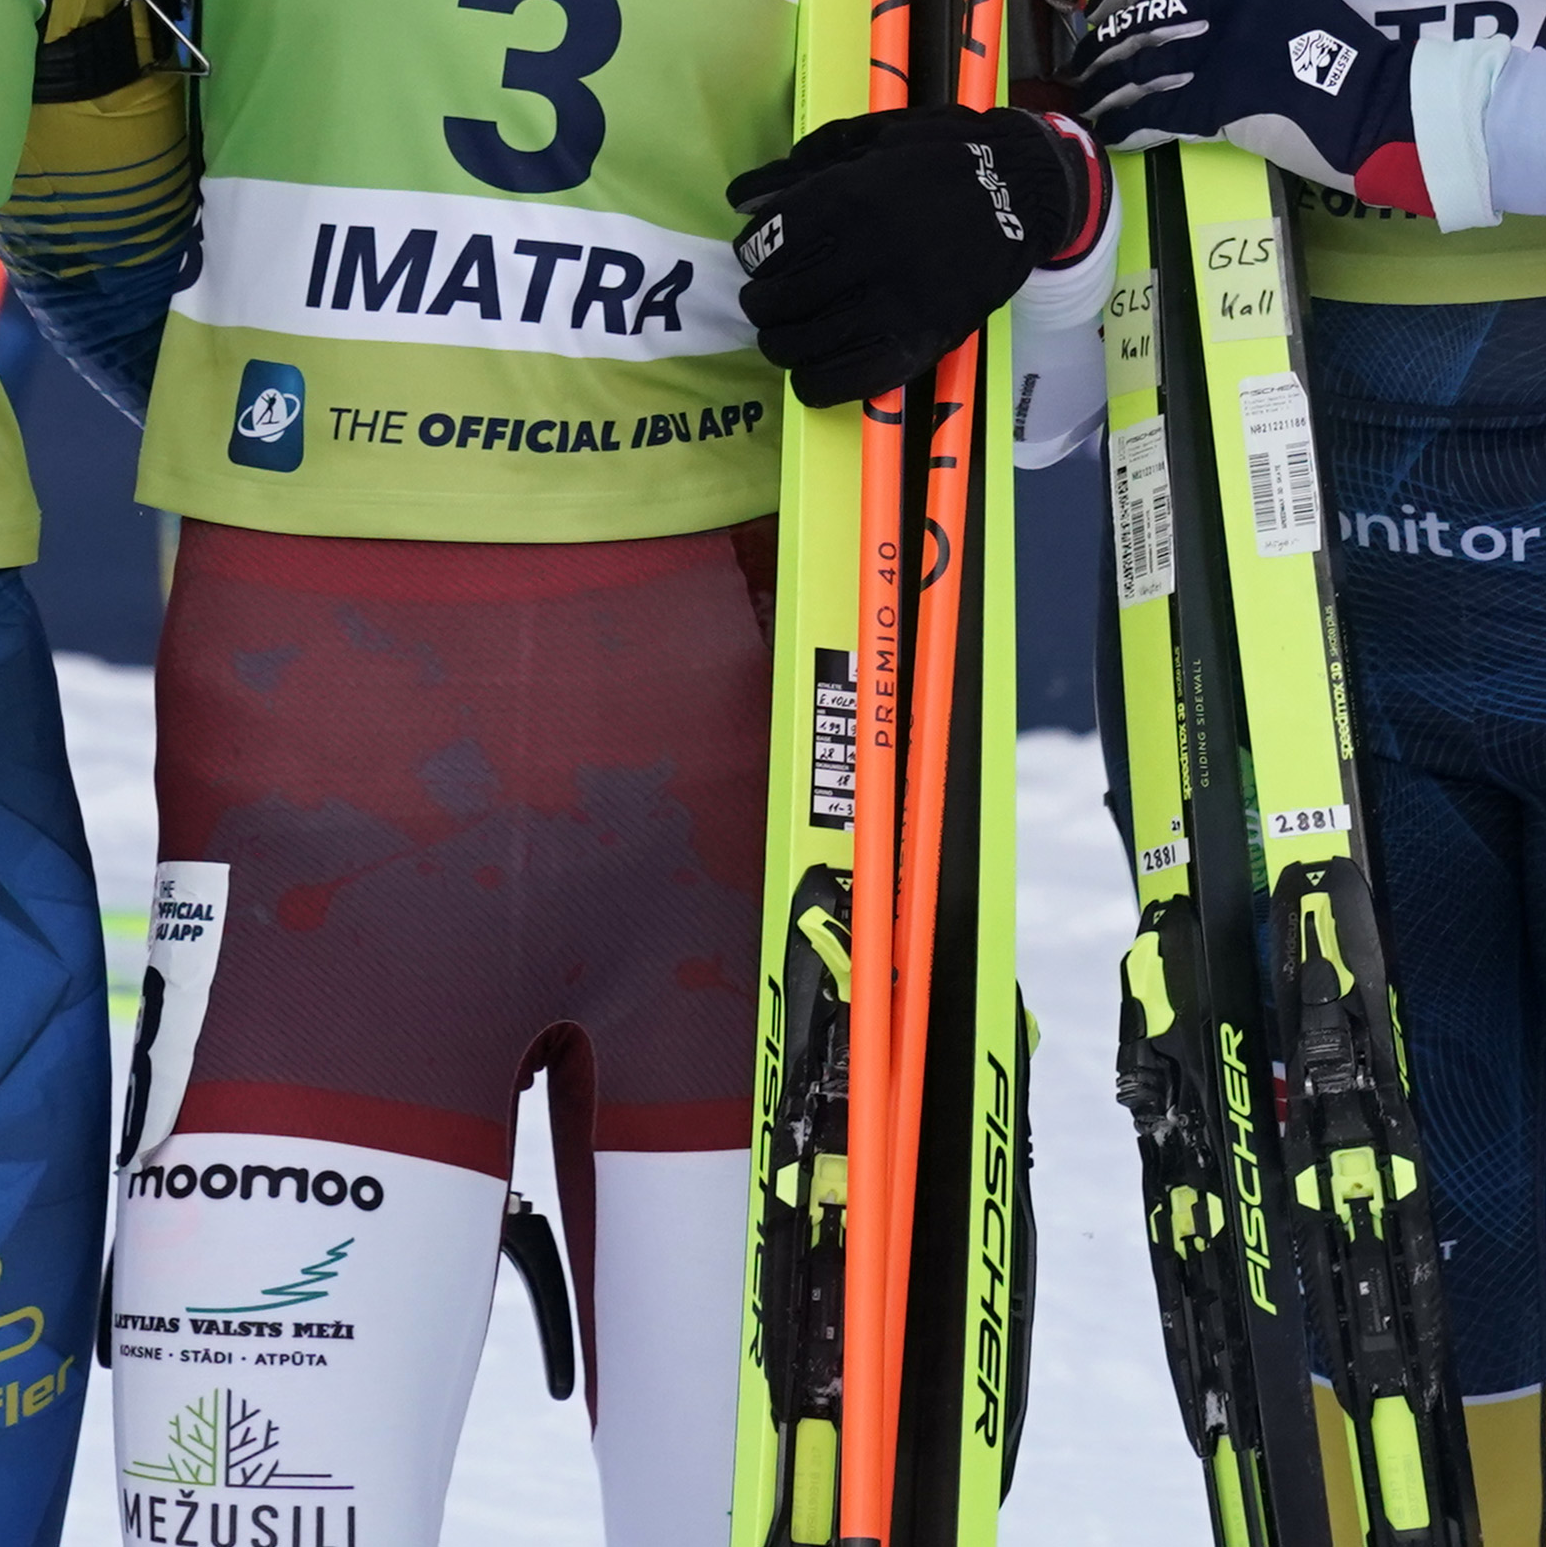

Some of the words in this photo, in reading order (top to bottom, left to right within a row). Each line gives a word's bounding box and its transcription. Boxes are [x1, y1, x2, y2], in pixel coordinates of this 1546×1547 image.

[1327, 48, 1353, 88] HESTRA
[305, 222, 694, 337] IMATRA
[1209, 237, 1275, 271] GLS
[330, 407, 409, 446] THE
[418, 411, 623, 455] OFFICIAL
[631, 408, 693, 451] IBU
[696, 399, 765, 442] APP
[877, 540, 897, 586] 40
[874, 604, 896, 750] PREMIO
[1193, 657, 1206, 726] SIDEWALL
[1329, 661, 1344, 681] 3D
[1176, 701, 1187, 721] 3D
[1333, 681, 1354, 762] speedmax
[1177, 721, 1193, 801] speedmax
[1197, 730, 1210, 789] GLIDING
[128, 1163, 384, 1212] moomoo
[1220, 1021, 1278, 1317] FISCHER
[973, 1050, 1011, 1449] FISCHER
[114, 1313, 181, 1334] LATVIJAS
[190, 1318, 283, 1339] VALSTS
[292, 1320, 355, 1341] MEŽI
[180, 1348, 233, 1365] STĀDI
[254, 1350, 329, 1367] ATPŪTA
